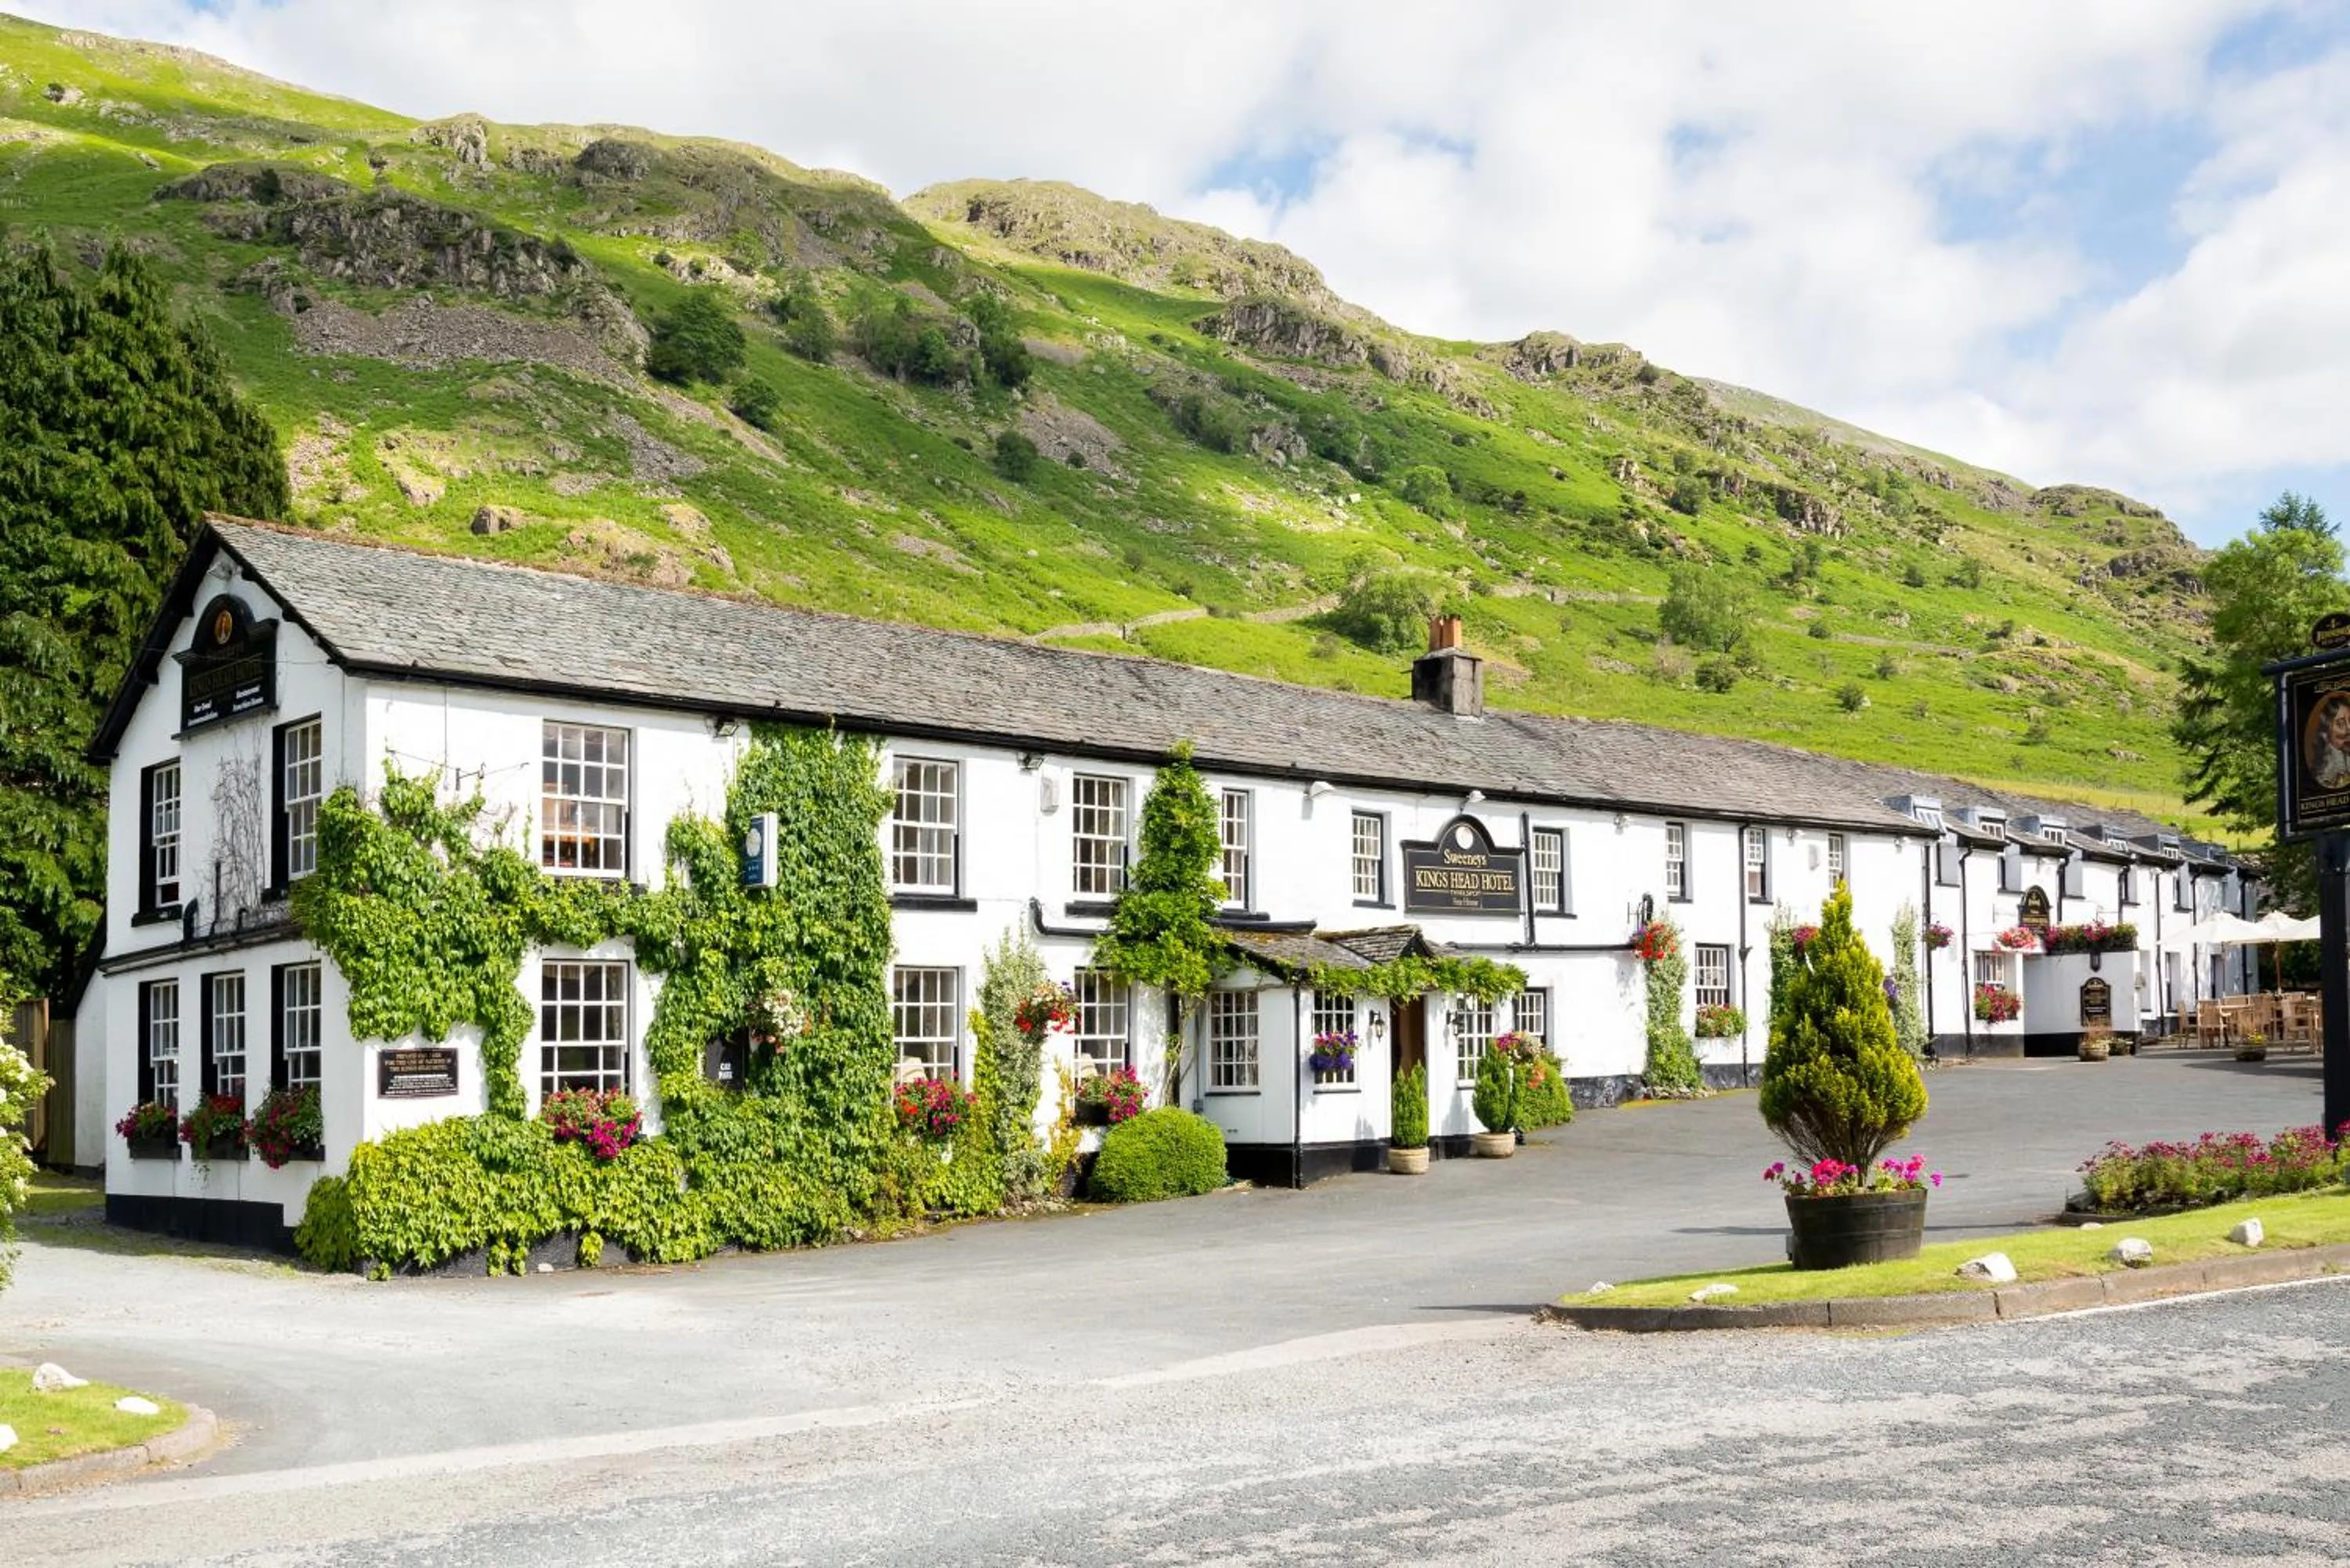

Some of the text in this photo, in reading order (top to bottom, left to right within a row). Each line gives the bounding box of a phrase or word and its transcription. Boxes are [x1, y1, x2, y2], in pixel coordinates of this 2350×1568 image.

[1415, 870, 1516, 891] KINGS HEAD HOTEL
